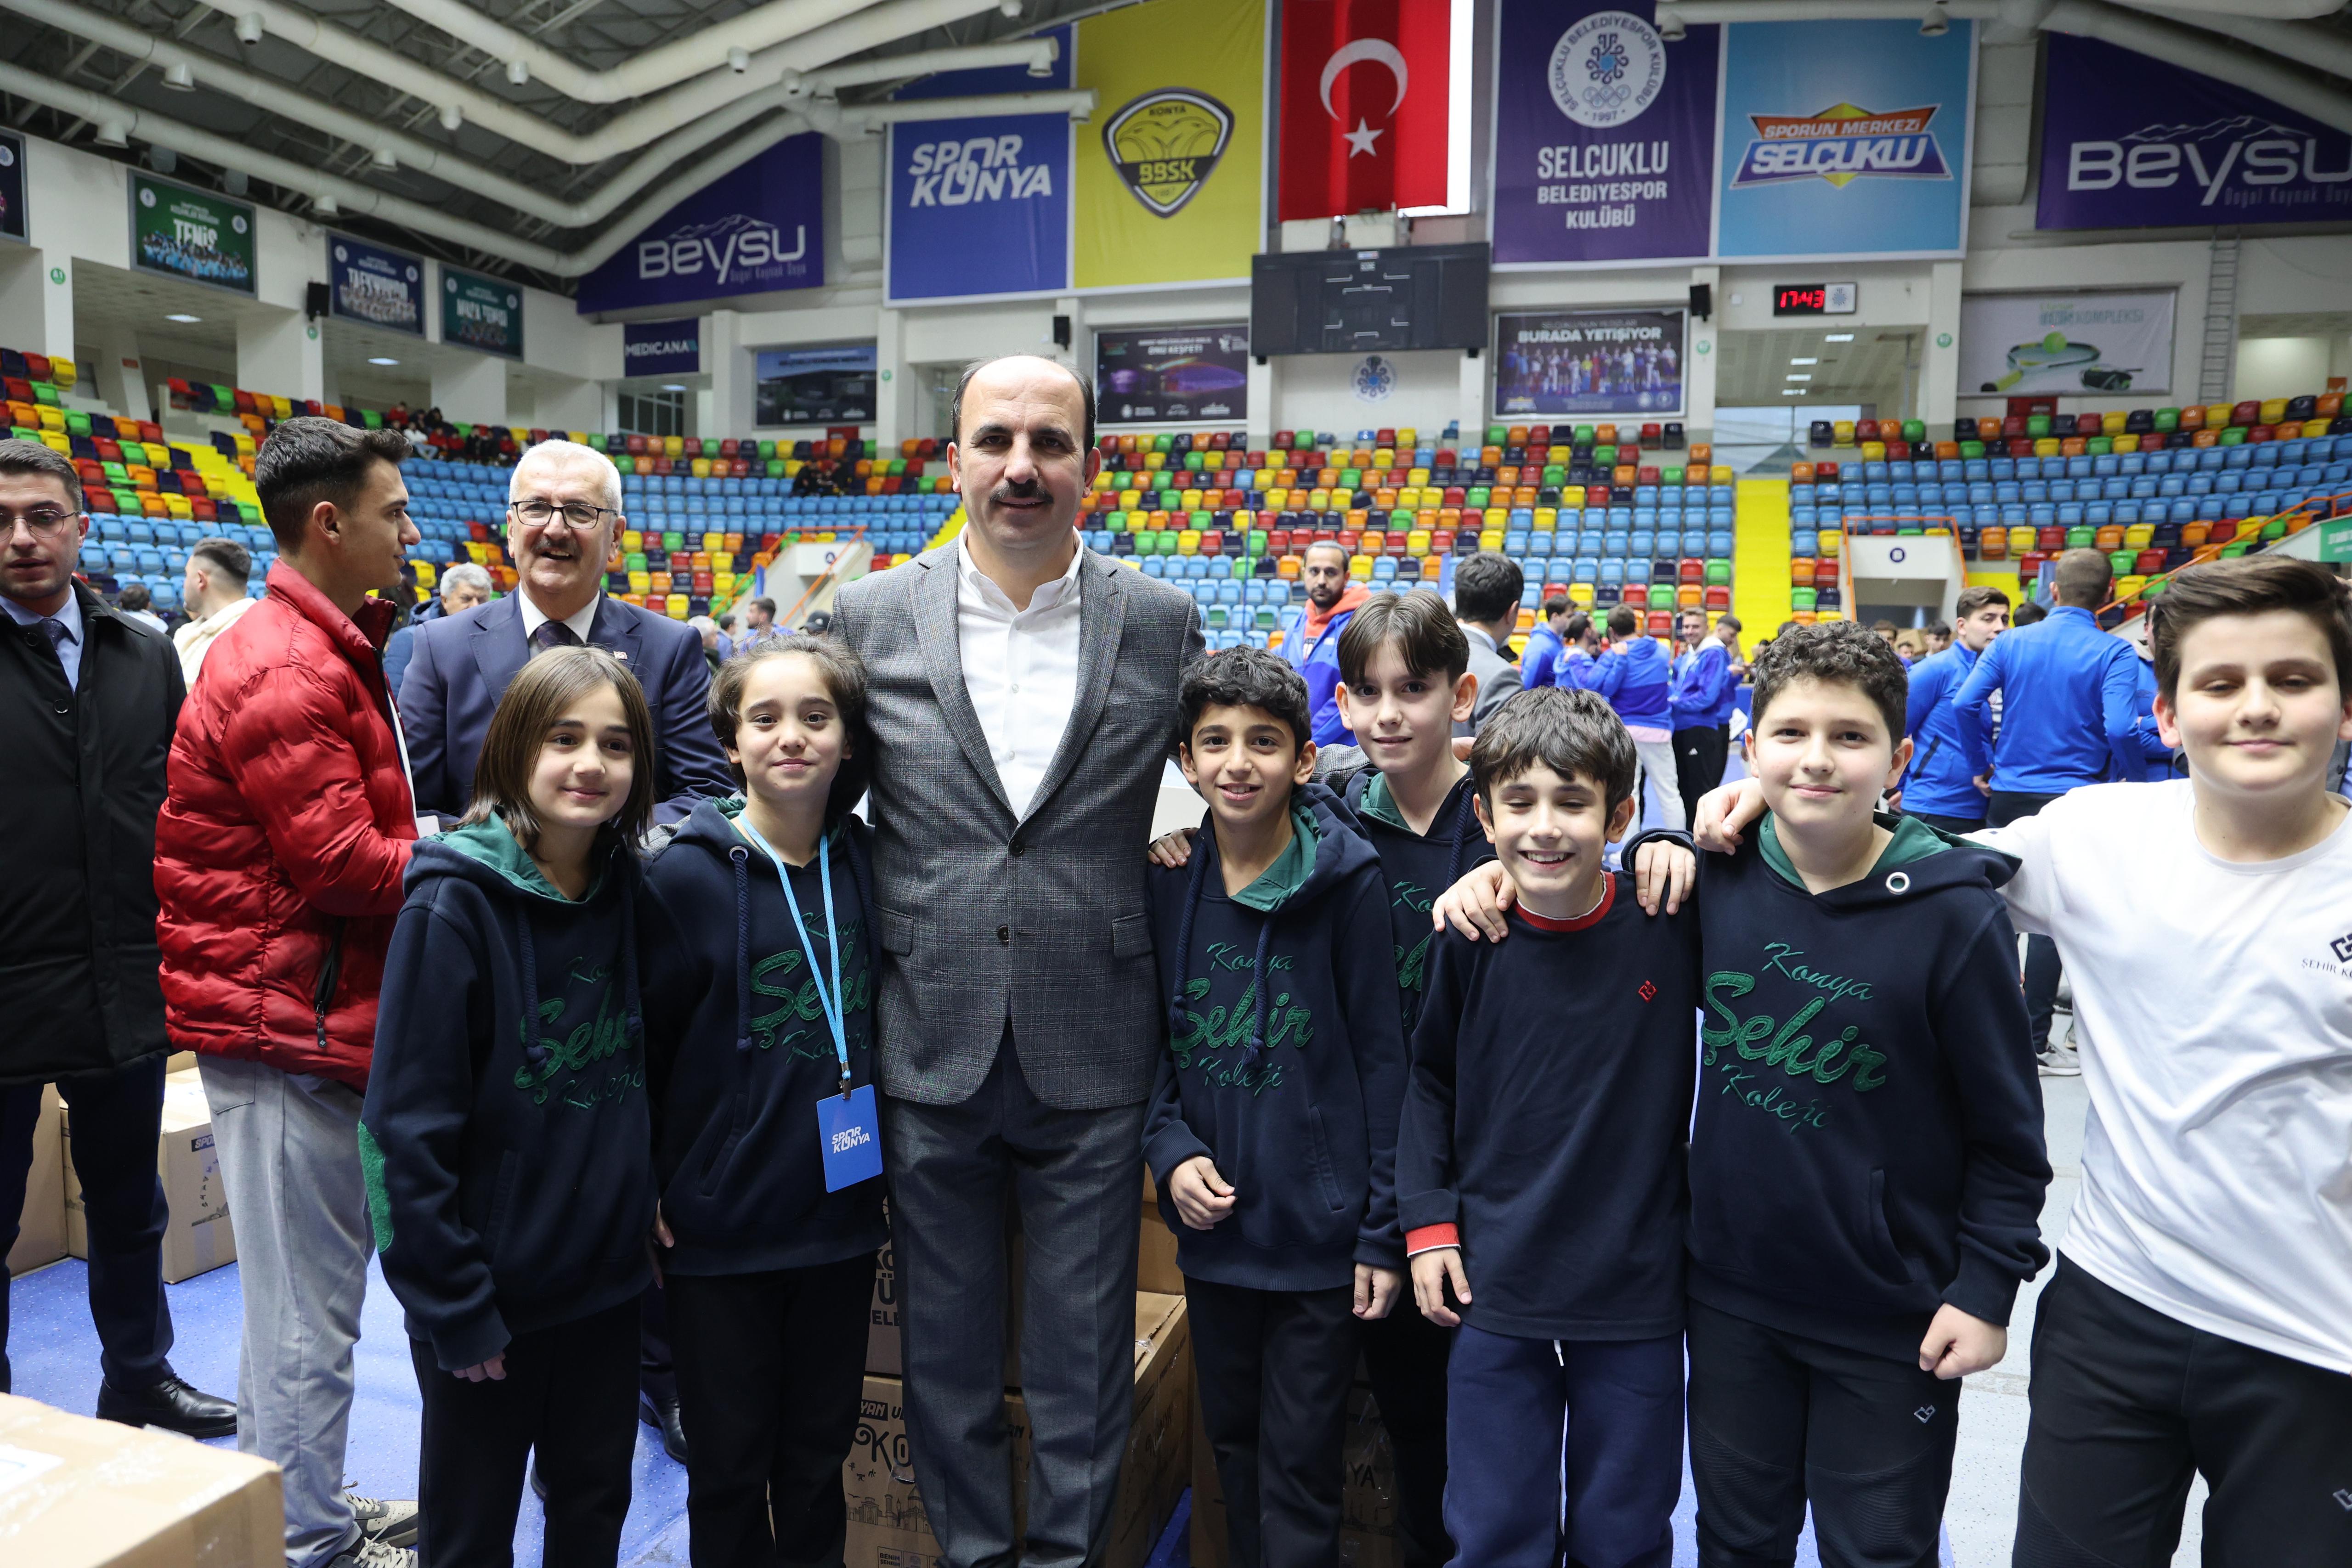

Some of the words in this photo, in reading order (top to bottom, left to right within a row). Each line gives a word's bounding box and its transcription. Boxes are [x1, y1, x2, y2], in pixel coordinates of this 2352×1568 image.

[1764, 122, 1838, 139] SPORUN
[908, 134, 1023, 184] SPOR
[1537, 141, 1669, 179] SELÇUKLU
[1751, 136, 1929, 175] SELÇUKLU
[1139, 158, 1196, 183] BBSK
[910, 161, 1052, 208] KONYA
[1537, 180, 1668, 205] BELEDİYESPOR
[1566, 203, 1636, 230] KULÜBÜ
[1780, 290, 1825, 308] 17:43
[1518, 329, 1583, 344] BURADA
[1761, 942, 1874, 1003] Konya
[1701, 970, 1888, 1092] Şehir
[1720, 1063, 1832, 1135] Koleji
[831, 1126, 862, 1145] SPOR
[833, 1132, 871, 1154] KONYA
